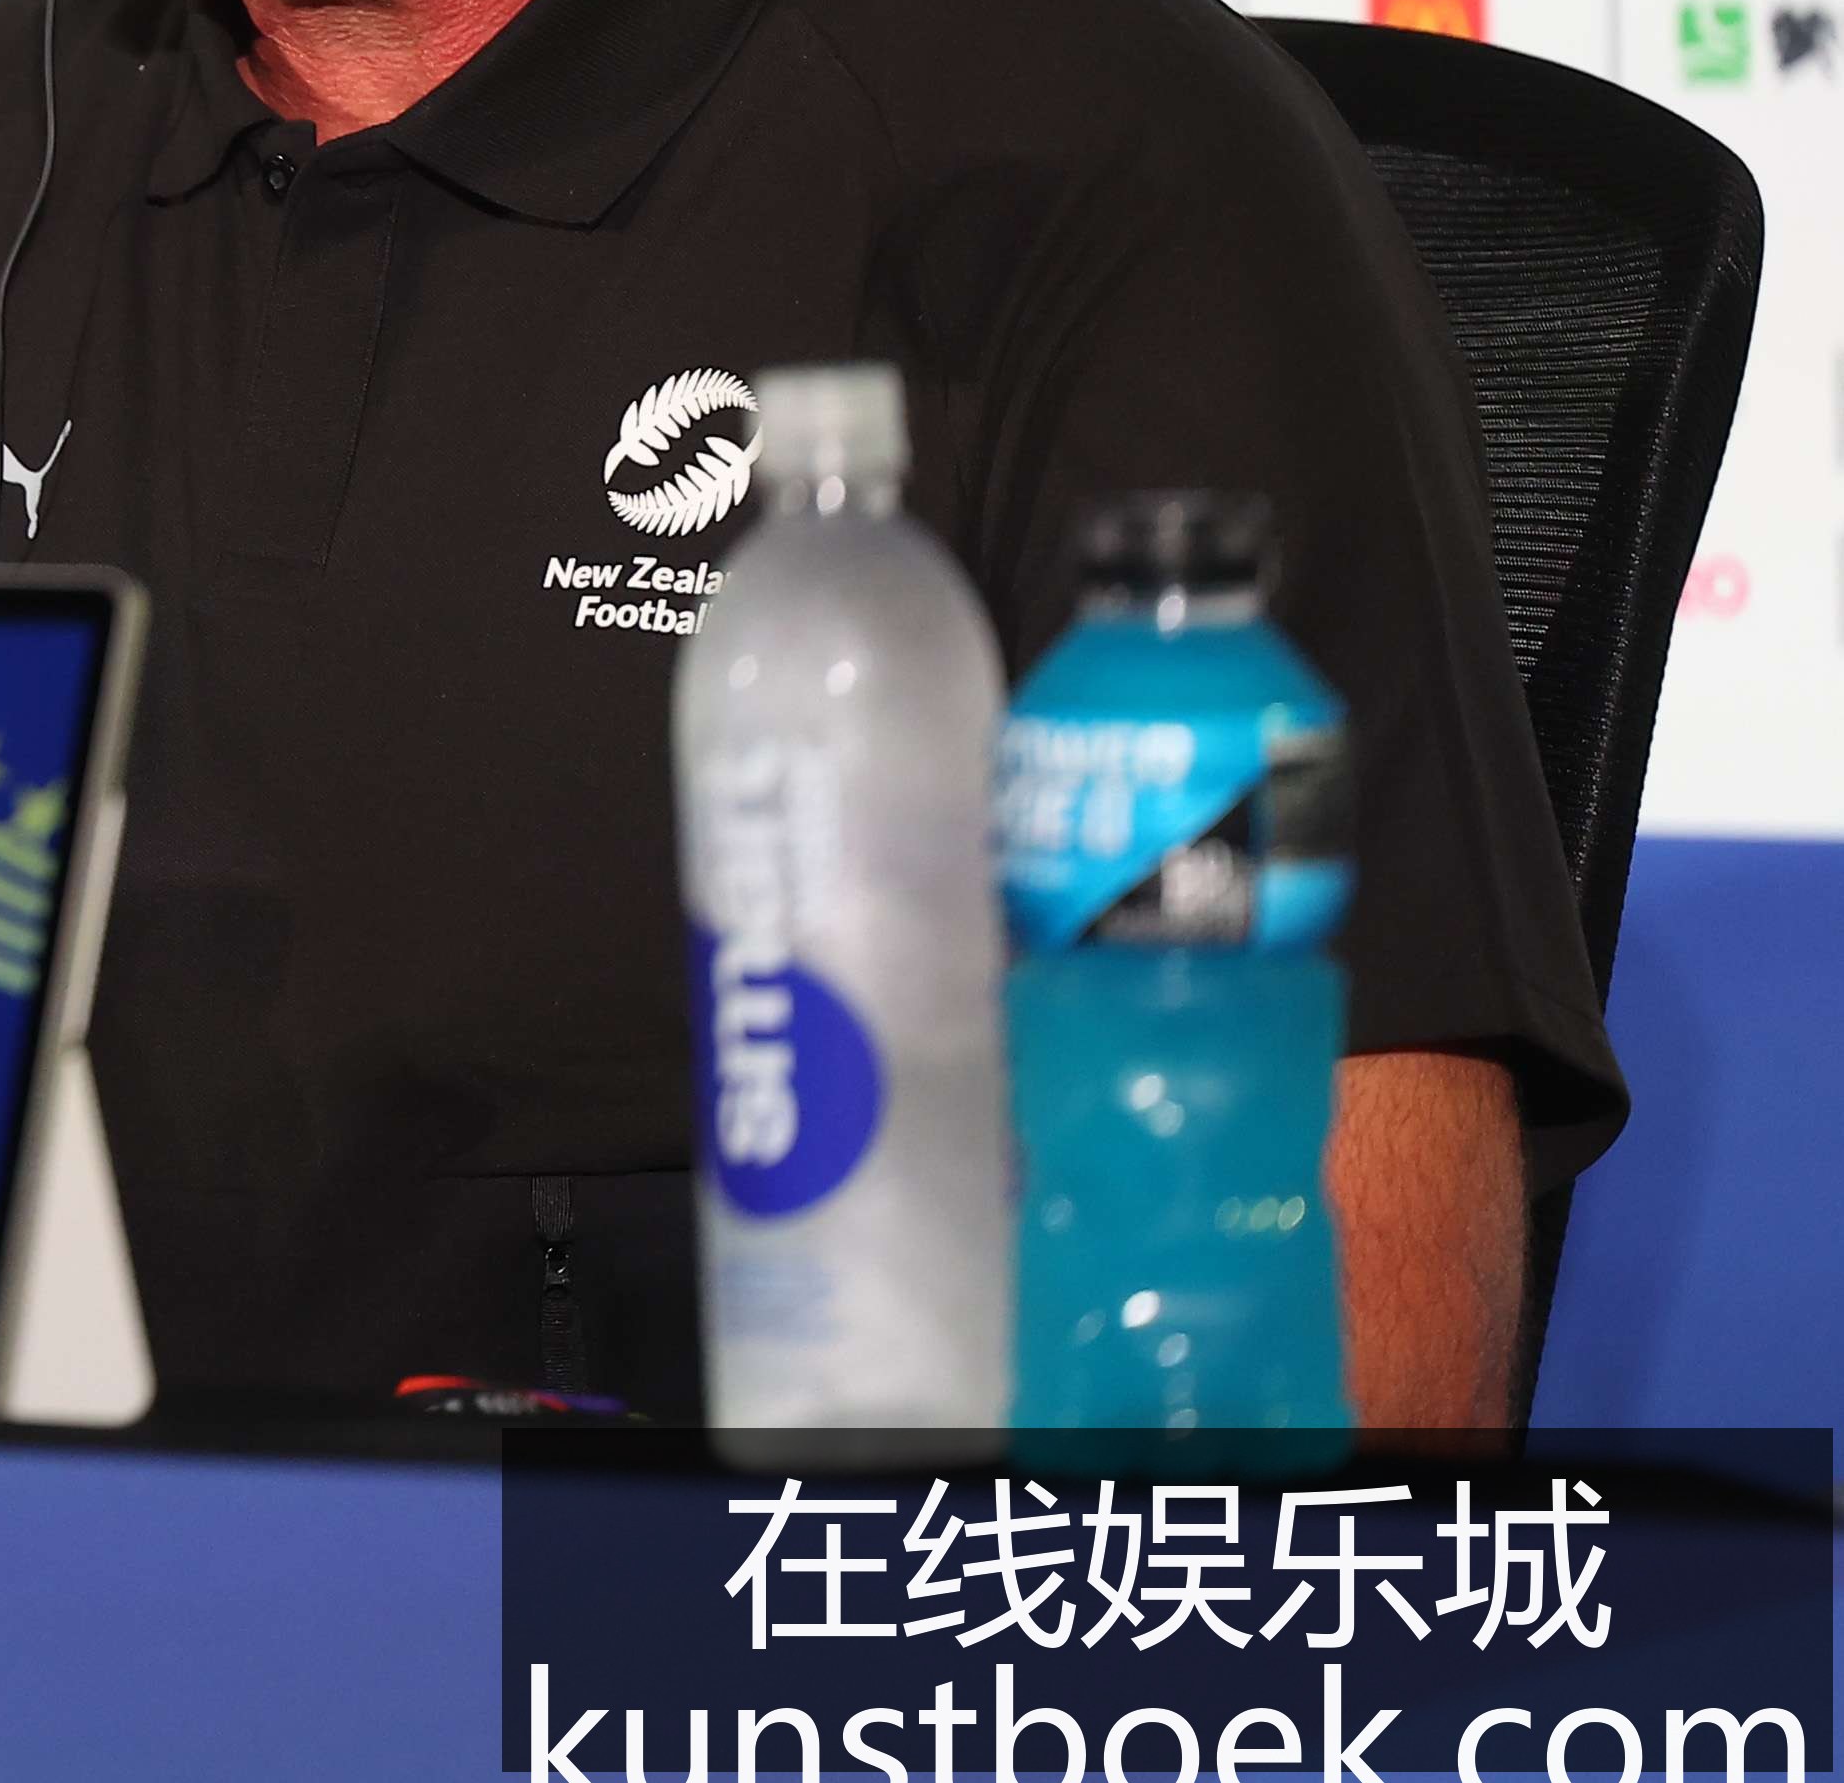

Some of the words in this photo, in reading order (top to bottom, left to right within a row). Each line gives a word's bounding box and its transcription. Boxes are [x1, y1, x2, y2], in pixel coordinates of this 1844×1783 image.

[542, 556, 623, 589] New
[626, 556, 731, 595] Zeala
[574, 595, 713, 635] Footbal
